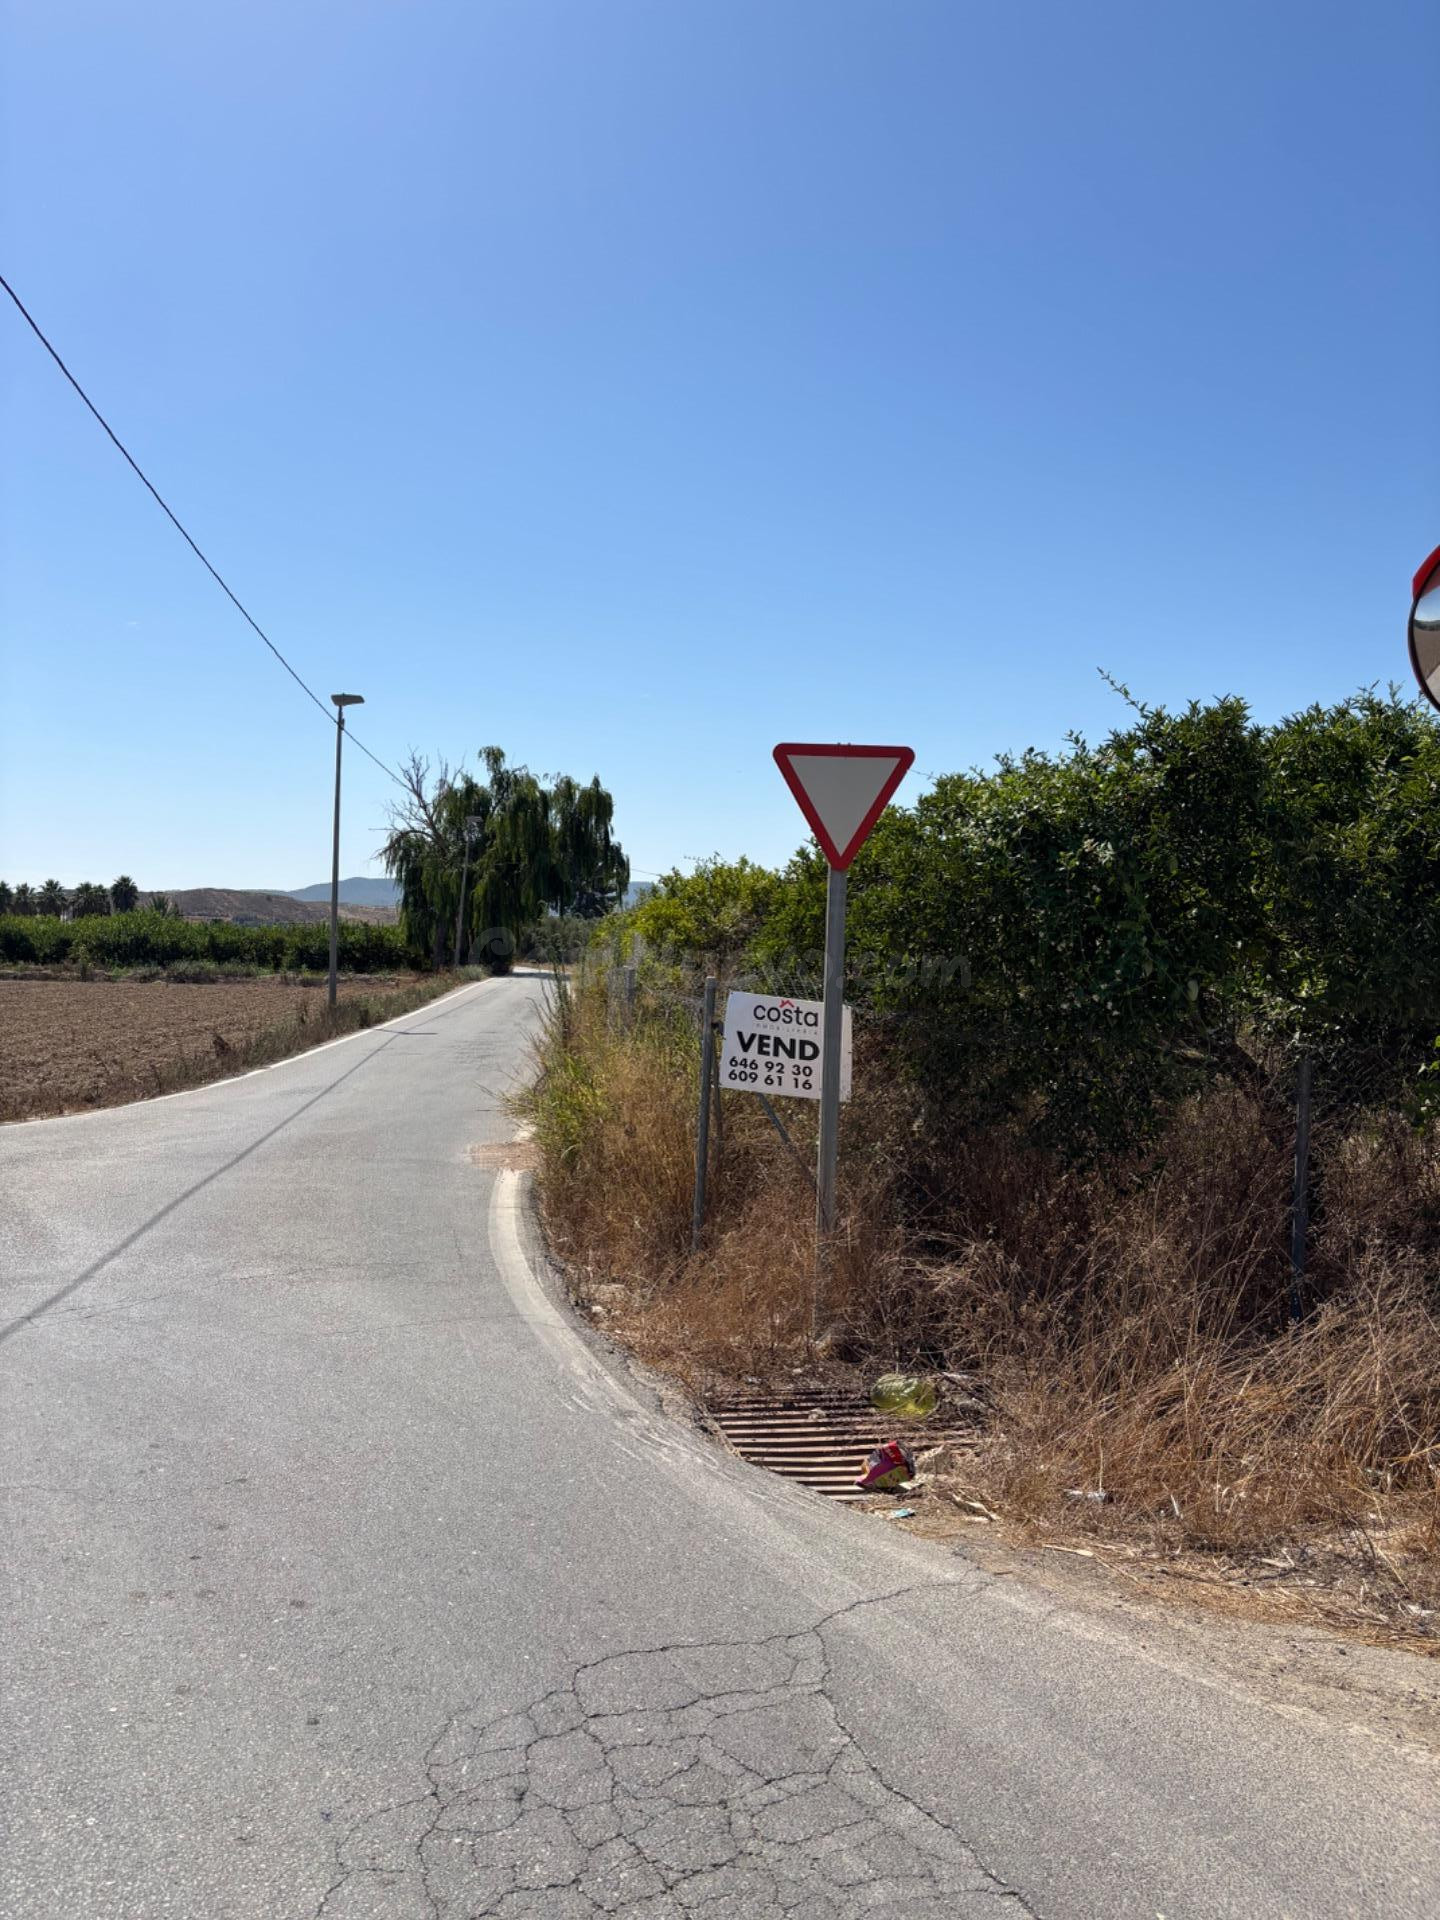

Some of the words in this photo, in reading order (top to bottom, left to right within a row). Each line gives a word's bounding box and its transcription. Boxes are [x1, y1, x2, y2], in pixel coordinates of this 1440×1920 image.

[753, 1005, 819, 1027] costa
[736, 1030, 820, 1061] VEND
[729, 1056, 759, 1071] 646
[765, 1061, 785, 1075] 92
[792, 1064, 813, 1077] 30
[728, 1070, 758, 1084] 609
[764, 1075, 783, 1086] 61
[793, 1078, 813, 1090] 16
